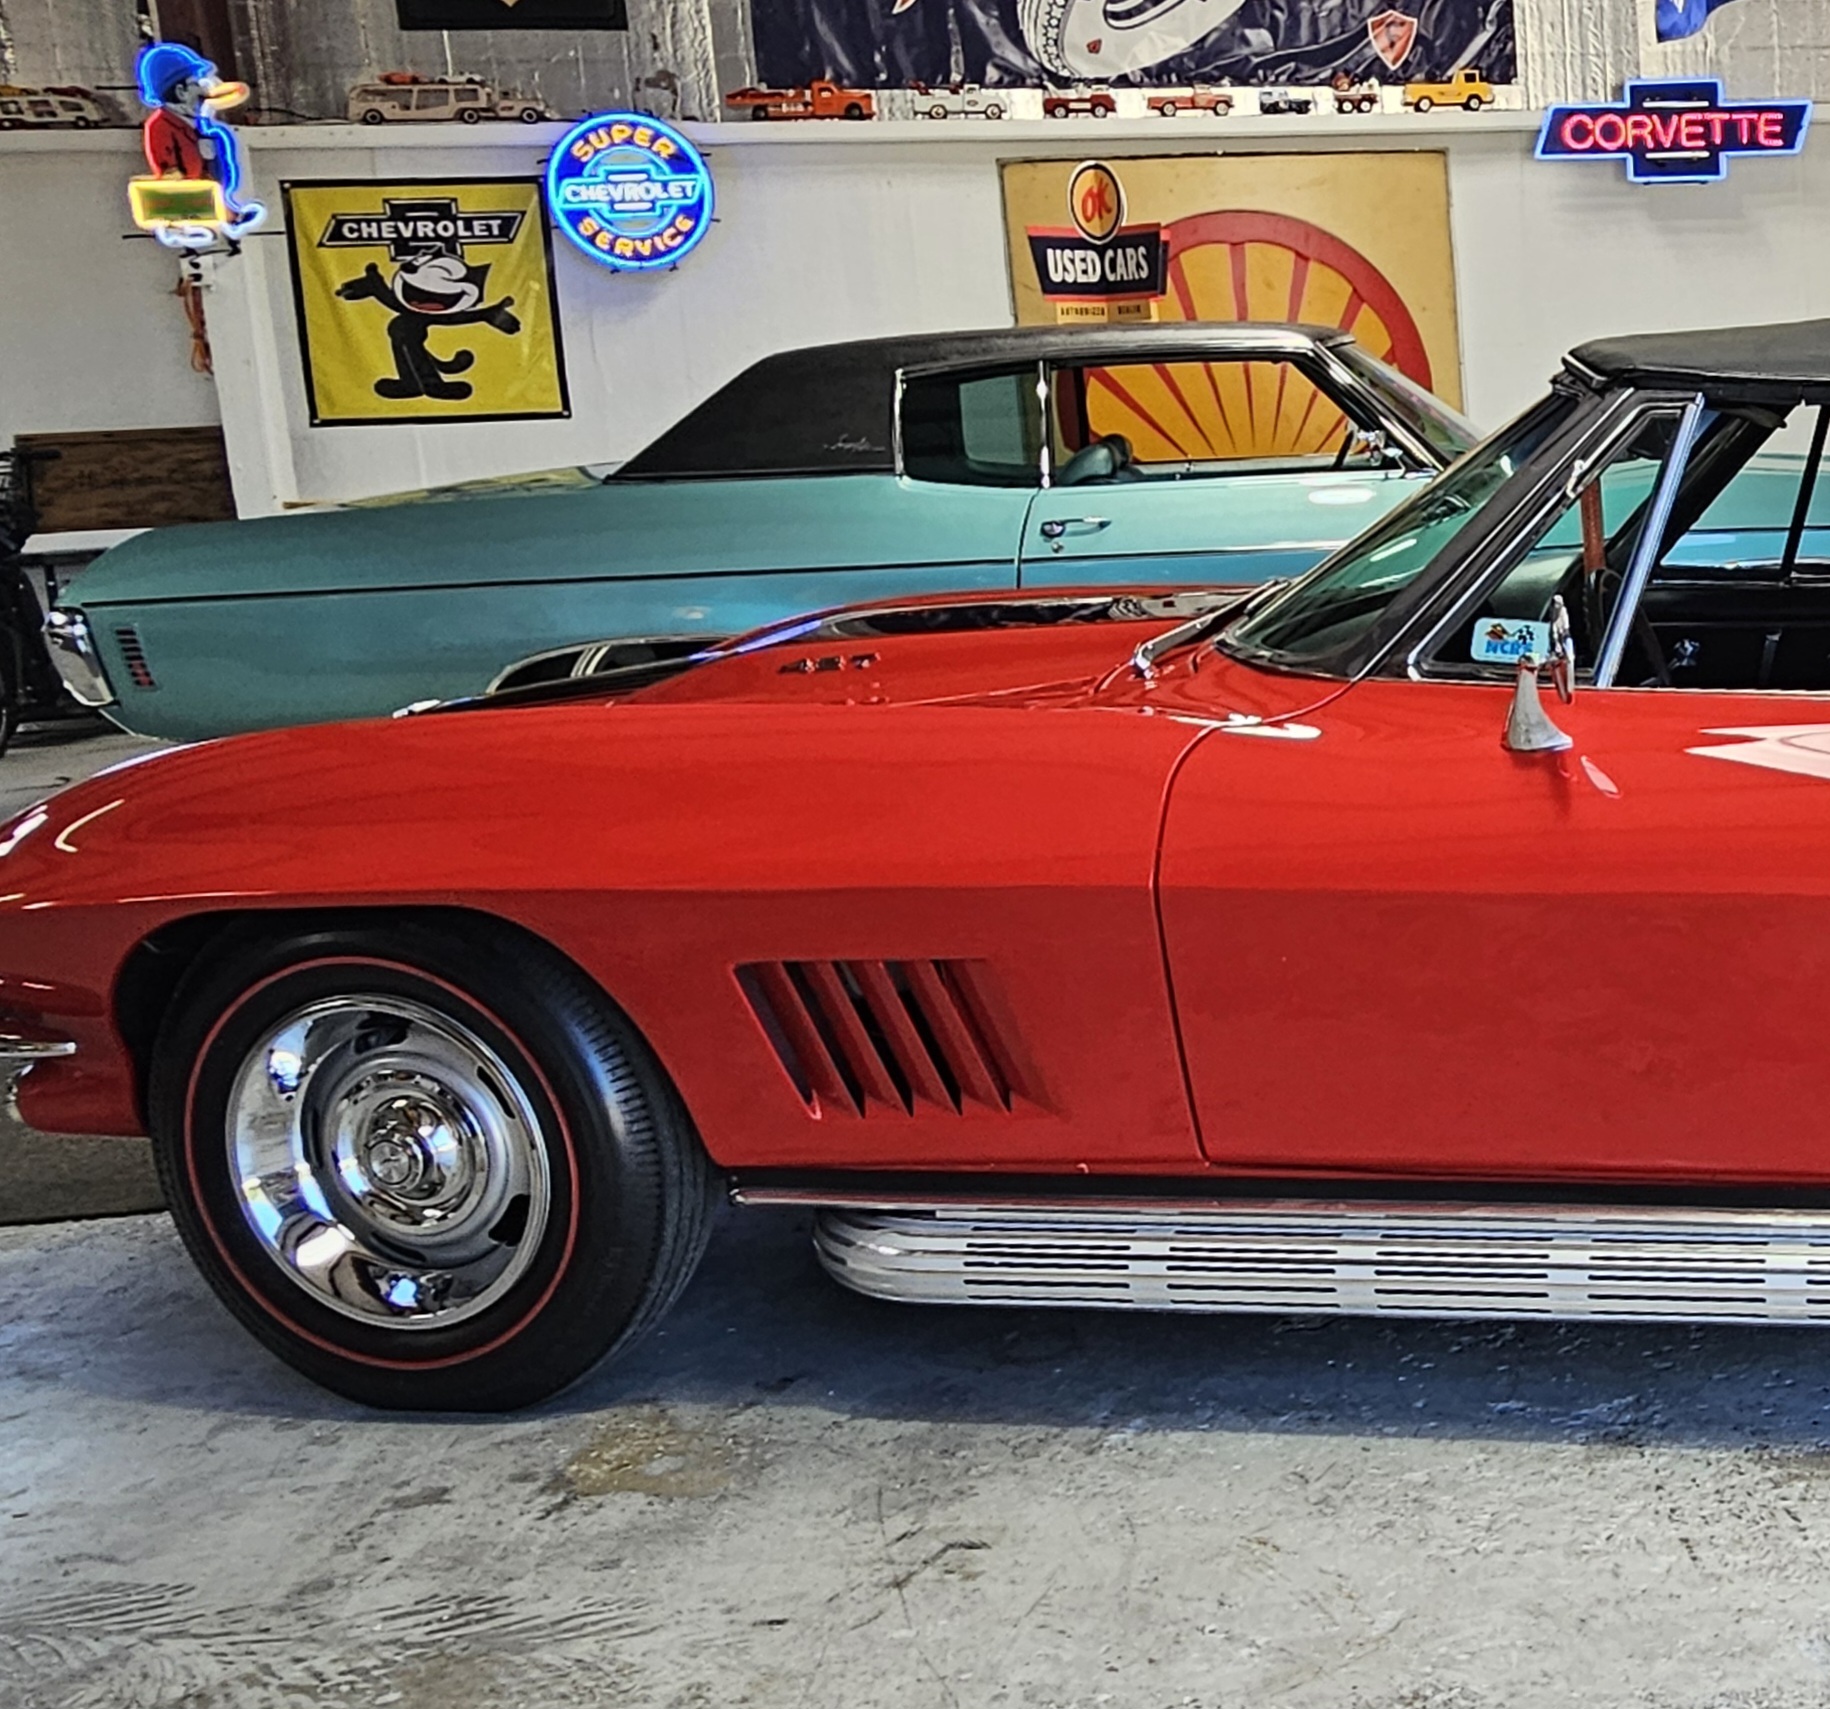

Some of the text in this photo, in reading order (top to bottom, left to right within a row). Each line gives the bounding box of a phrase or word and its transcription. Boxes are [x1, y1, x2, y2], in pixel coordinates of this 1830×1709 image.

[570, 123, 678, 162] SUPER
[1560, 112, 1785, 150] CORVETTE
[564, 179, 698, 203] CHEVROLET
[1081, 177, 1113, 224] OK
[341, 218, 502, 239] CHEVROLET
[577, 213, 695, 258] SERVICE
[1046, 245, 1150, 284] USED CARS
